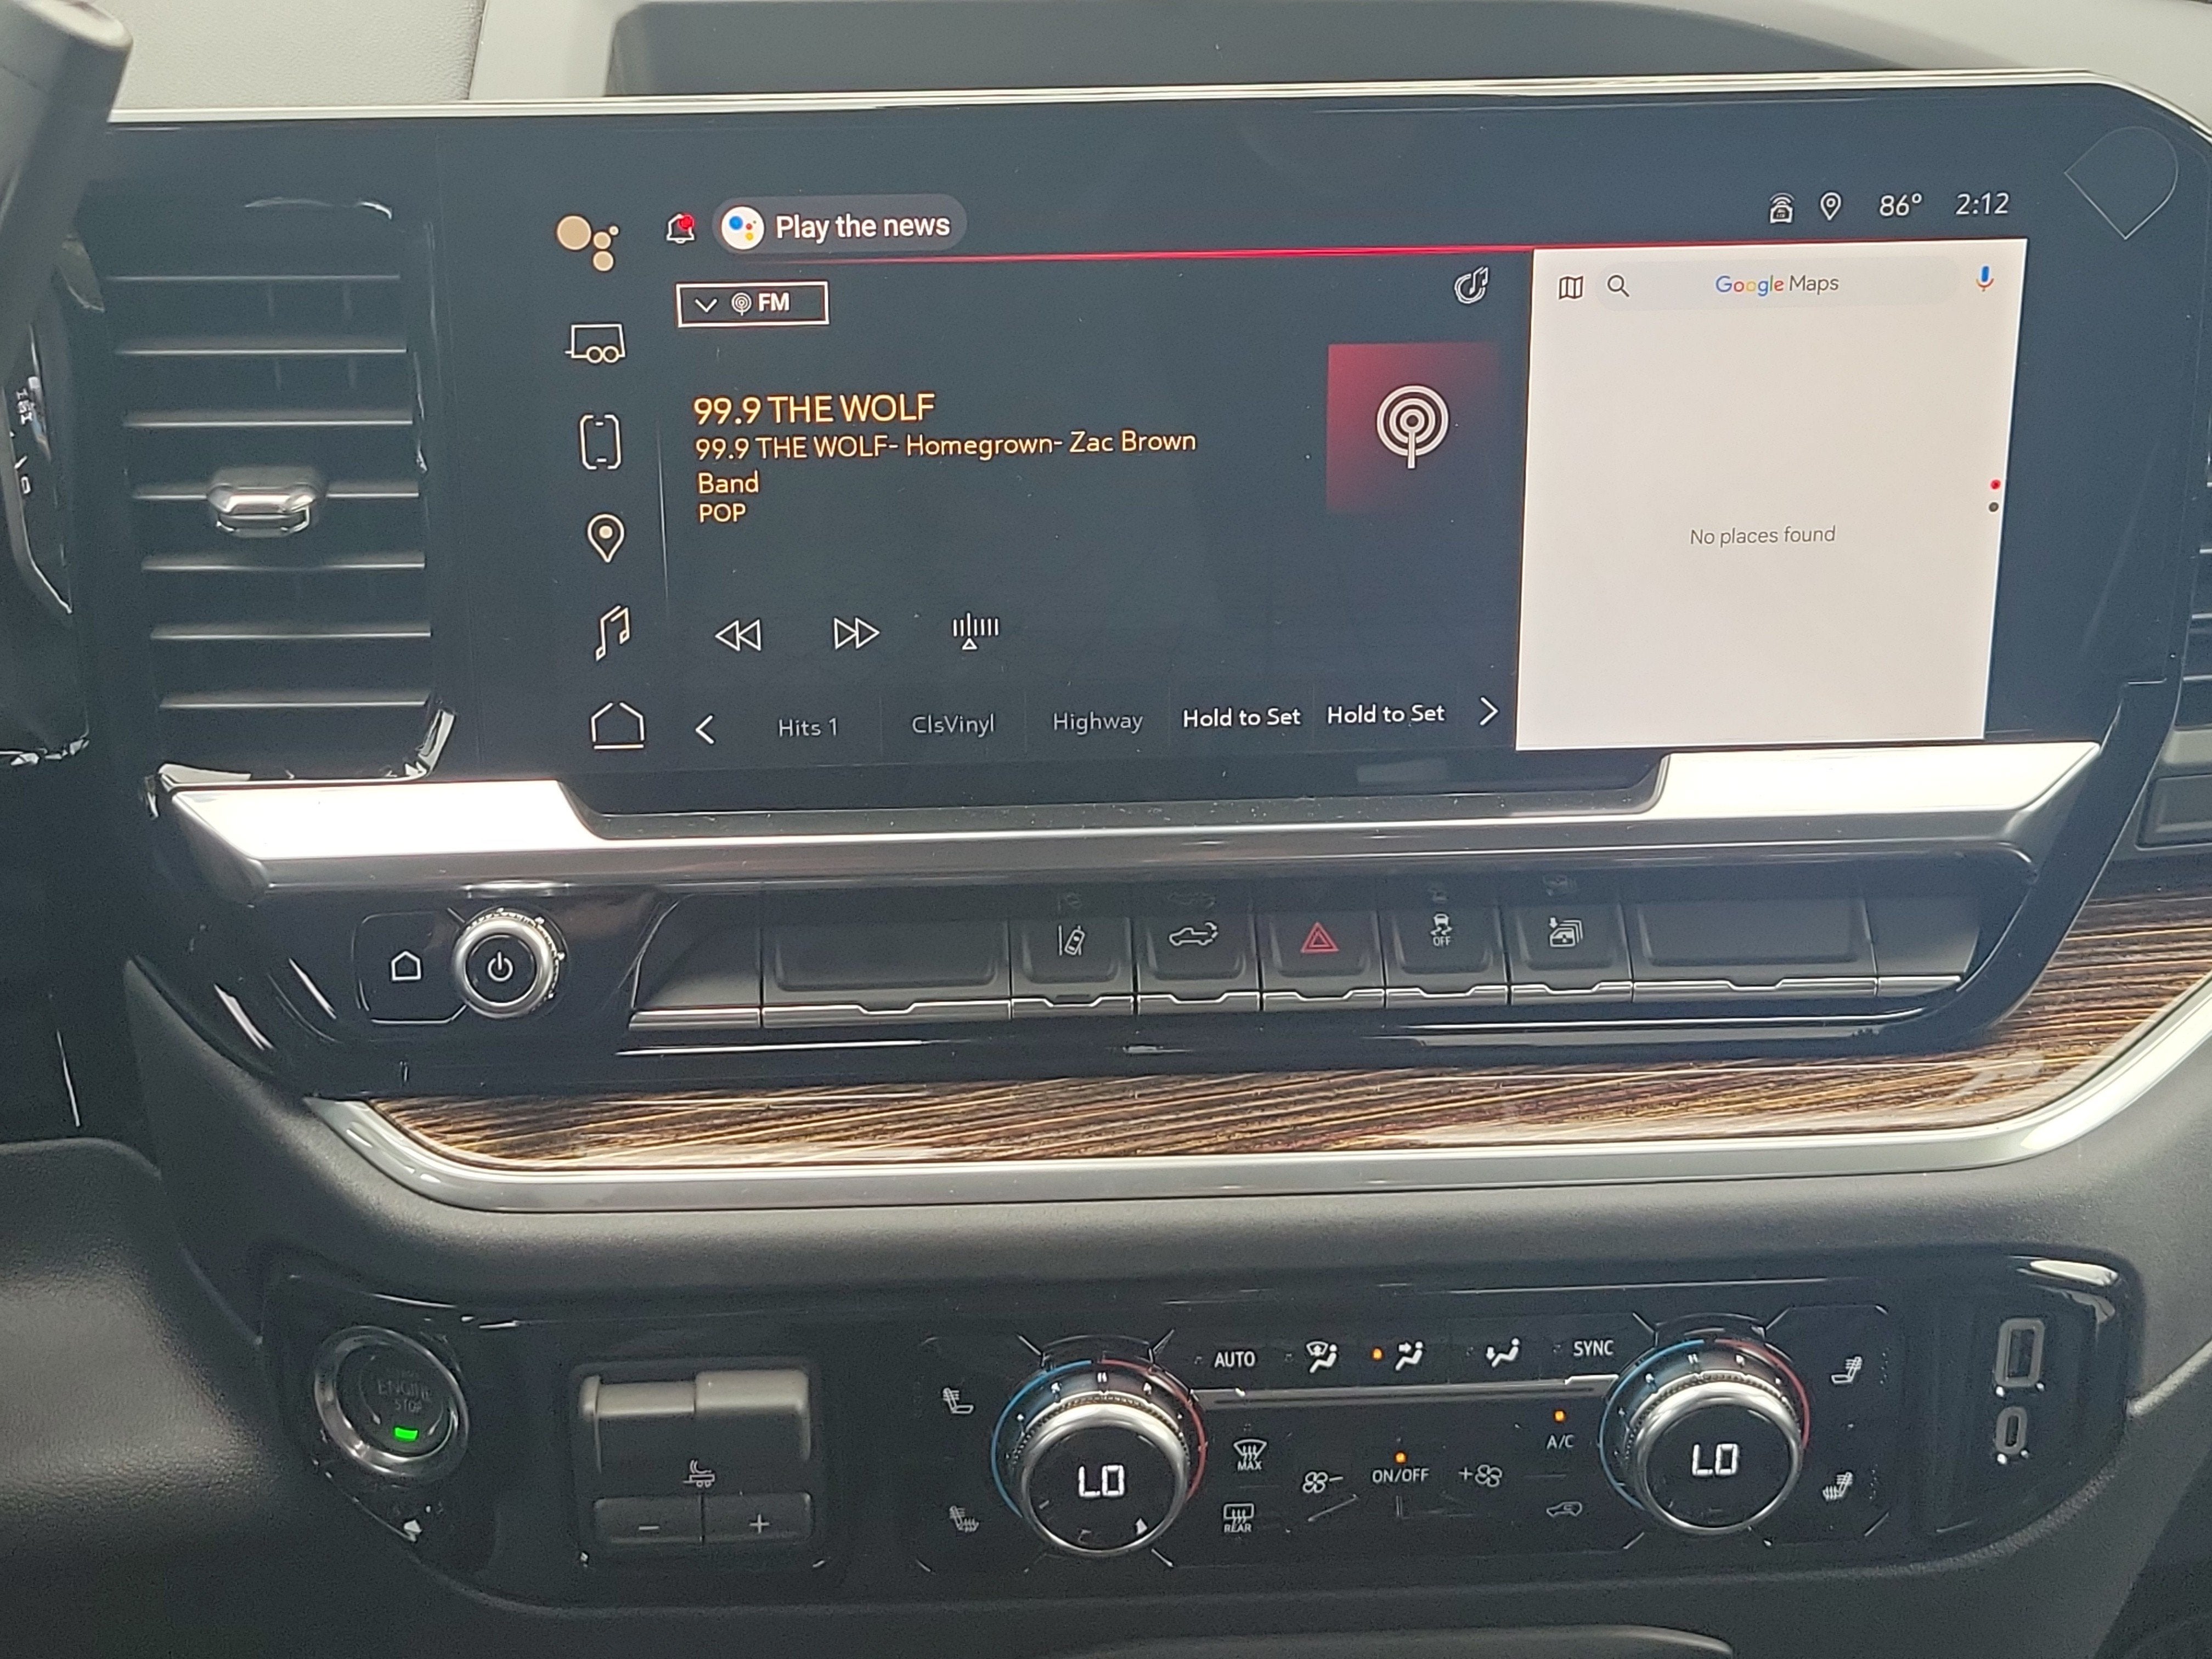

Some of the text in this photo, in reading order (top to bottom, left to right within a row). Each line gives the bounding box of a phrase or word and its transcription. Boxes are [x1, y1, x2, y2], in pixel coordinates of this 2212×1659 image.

[1956, 193, 2009, 215] 2:12
[776, 213, 950, 244] Play the news
[1716, 275, 1839, 297] Google Maps
[759, 292, 789, 312] FM
[694, 393, 935, 425] 99.9 THE WOLF
[696, 438, 749, 460] 99.9
[755, 436, 808, 459] THE
[1069, 431, 1114, 453] Zac
[1122, 430, 1195, 452] Brown
[698, 470, 759, 494] Band
[699, 503, 746, 523] POP
[1690, 524, 1836, 548] No places found
[1054, 711, 1143, 735] Highway
[1183, 707, 1301, 727] Hold to Set
[1328, 704, 1445, 724] Hold to Set
[779, 718, 836, 737] Hits 1
[912, 713, 994, 738] ClsVinyl
[1432, 936, 1451, 946] OFF
[1573, 1340, 1613, 1356] SYNC
[1214, 1351, 1255, 1368] AUTO
[1547, 1434, 1574, 1449] A/C
[1237, 1460, 1262, 1470] MAX
[1372, 1468, 1429, 1483] ON/OFF
[1224, 1521, 1251, 1533] REAR
